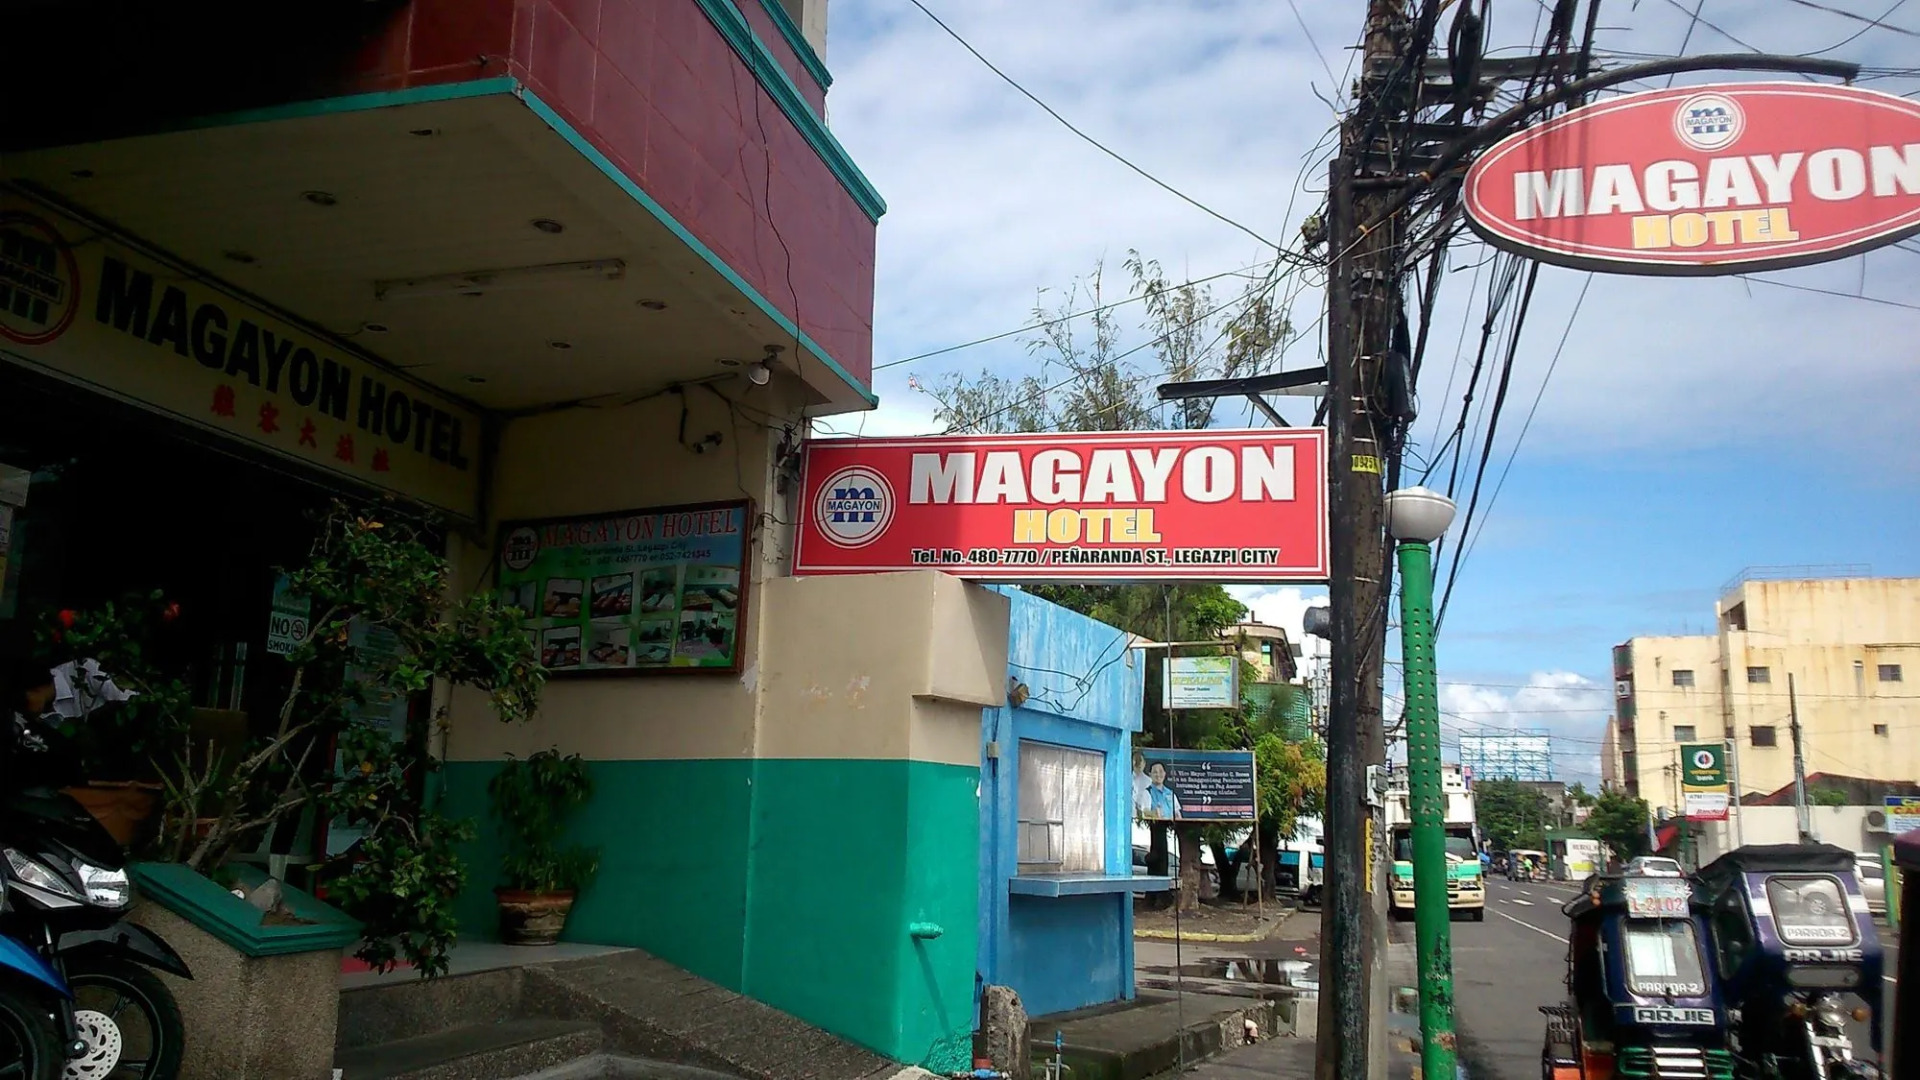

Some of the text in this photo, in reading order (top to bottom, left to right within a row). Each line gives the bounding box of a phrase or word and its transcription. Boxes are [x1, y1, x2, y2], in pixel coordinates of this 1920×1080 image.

[1687, 116, 1732, 126] MAGAYON
[1514, 143, 1920, 221] MAGAYON
[1632, 207, 1800, 249] HOTEL
[95, 255, 351, 421] MAGAYON
[358, 376, 469, 471] HOTEL
[908, 445, 1296, 504] MAGAYON
[828, 500, 881, 511] MAGAYON
[542, 508, 738, 546] MAGAYON HOTEL
[1013, 509, 1161, 544] HOTEL
[911, 549, 939, 564] Tel.
[940, 549, 966, 564] No.
[967, 549, 1037, 564] 480-7770
[1051, 547, 1144, 564] PEÑARANDA
[1174, 549, 1238, 564] LEGAZPI
[1239, 549, 1280, 564] CITY
[271, 617, 290, 636] NO
[1783, 949, 1864, 962] ARJIE
[1638, 1009, 1713, 1023] ARJIE
